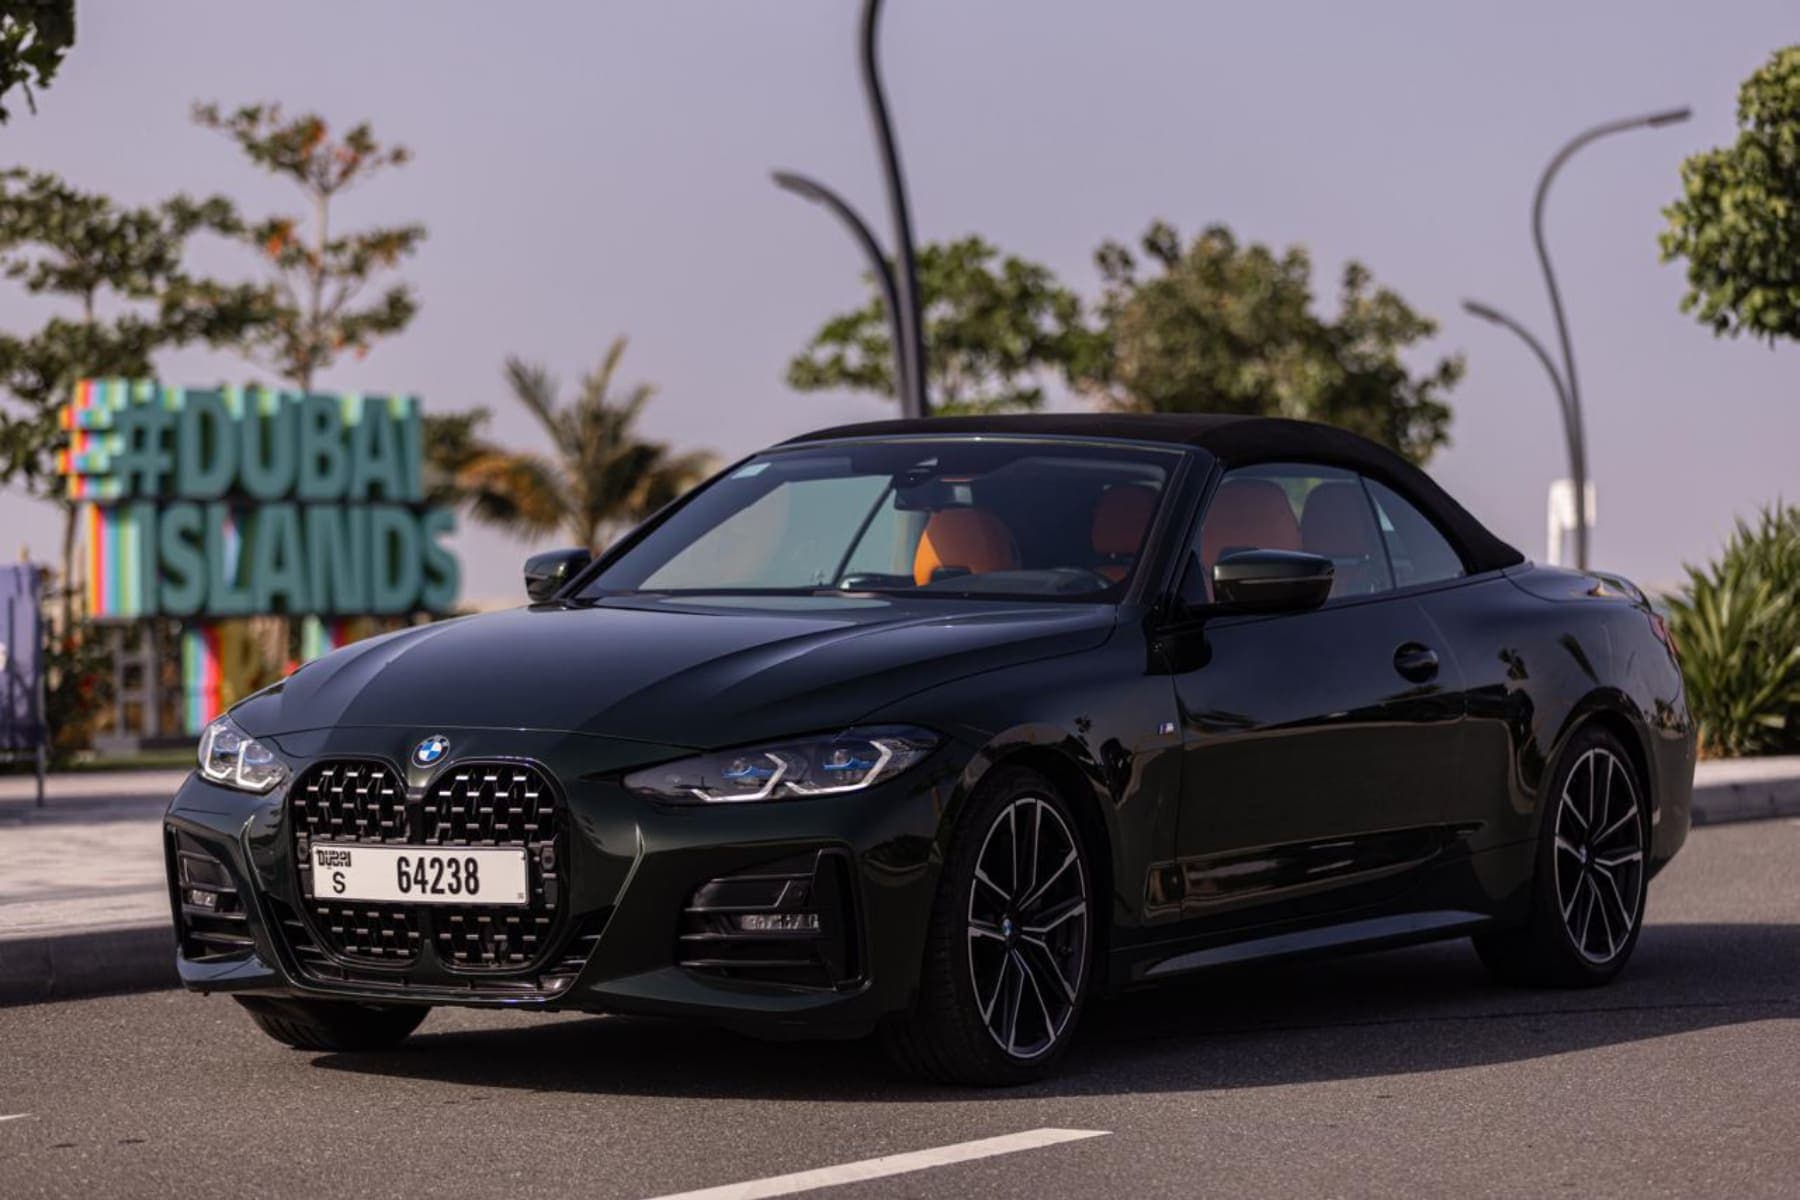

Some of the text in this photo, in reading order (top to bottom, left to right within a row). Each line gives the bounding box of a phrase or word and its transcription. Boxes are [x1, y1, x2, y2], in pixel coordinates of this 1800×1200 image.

[106, 385, 422, 499] #DUBAI
[135, 503, 460, 616] ISLANDS
[332, 871, 346, 894] S
[397, 856, 480, 895] 64238
